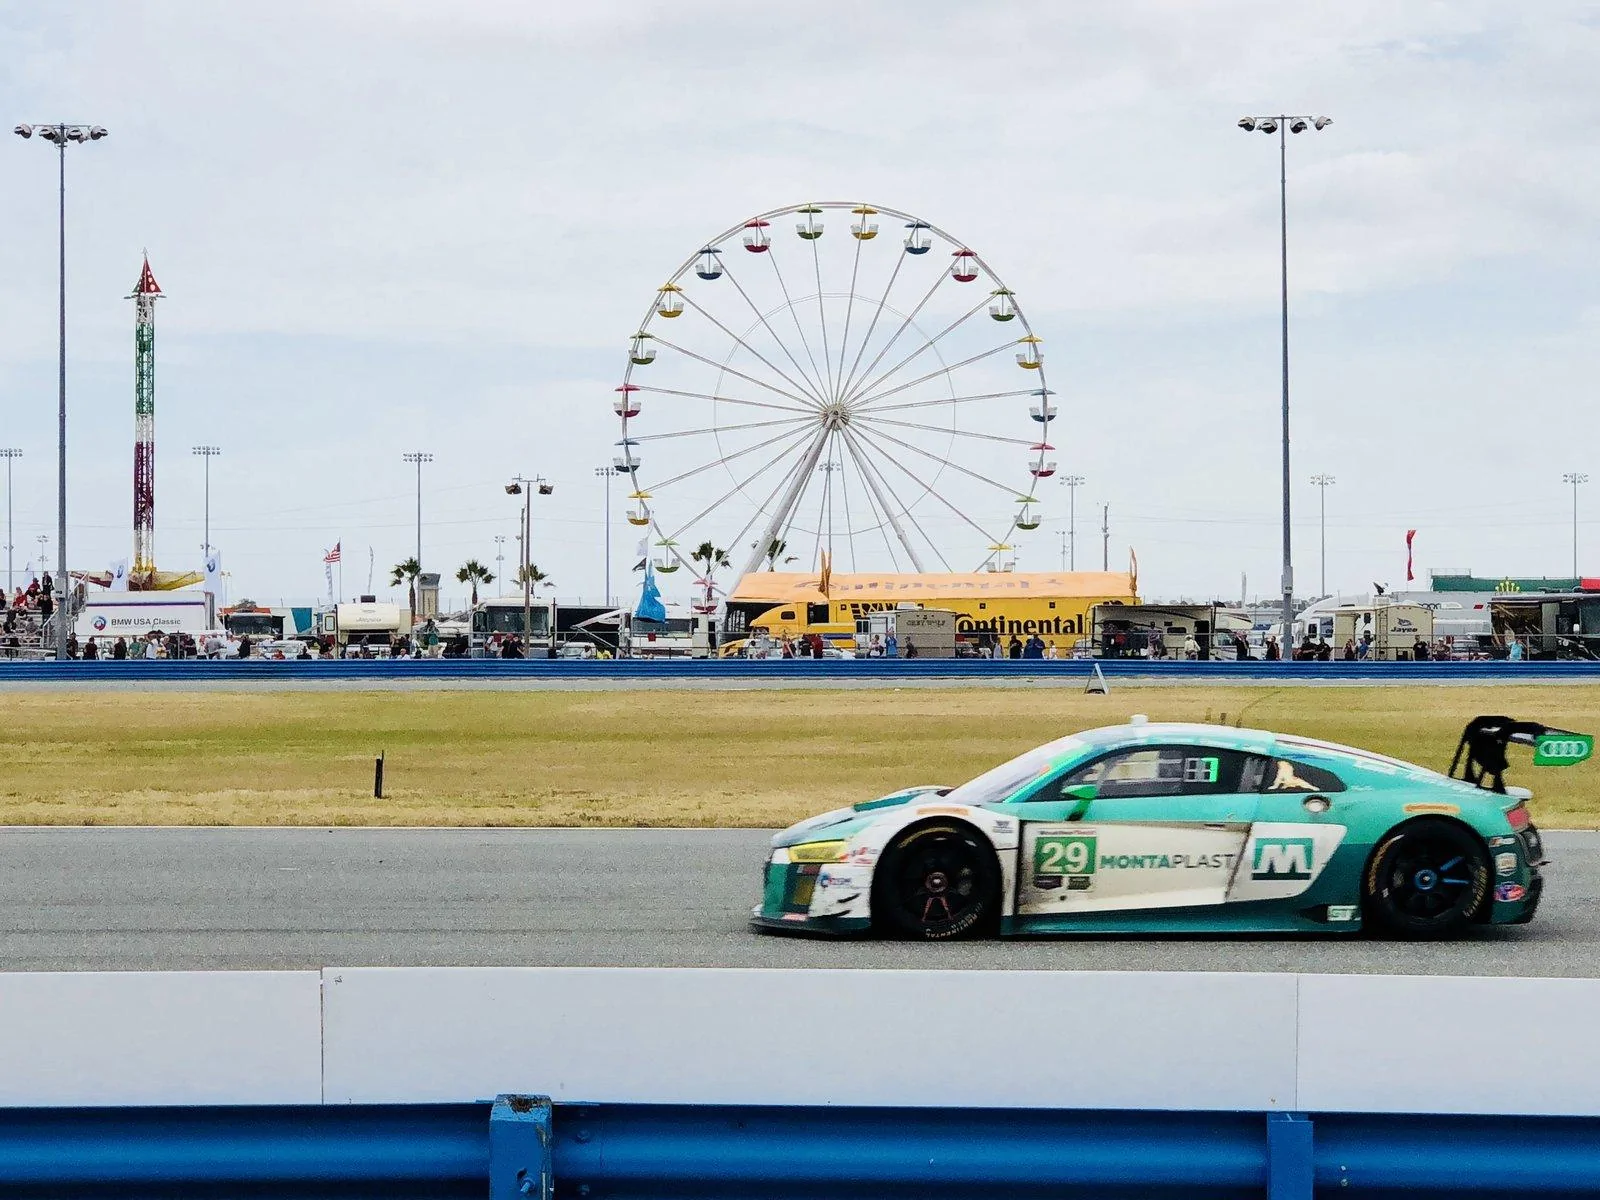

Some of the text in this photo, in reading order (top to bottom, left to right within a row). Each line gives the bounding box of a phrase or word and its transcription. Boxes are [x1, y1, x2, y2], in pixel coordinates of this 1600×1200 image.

[111, 617, 181, 626] BMW USA Classic
[1040, 841, 1089, 873] 29
[1099, 853, 1235, 869] MONTAPLAST
